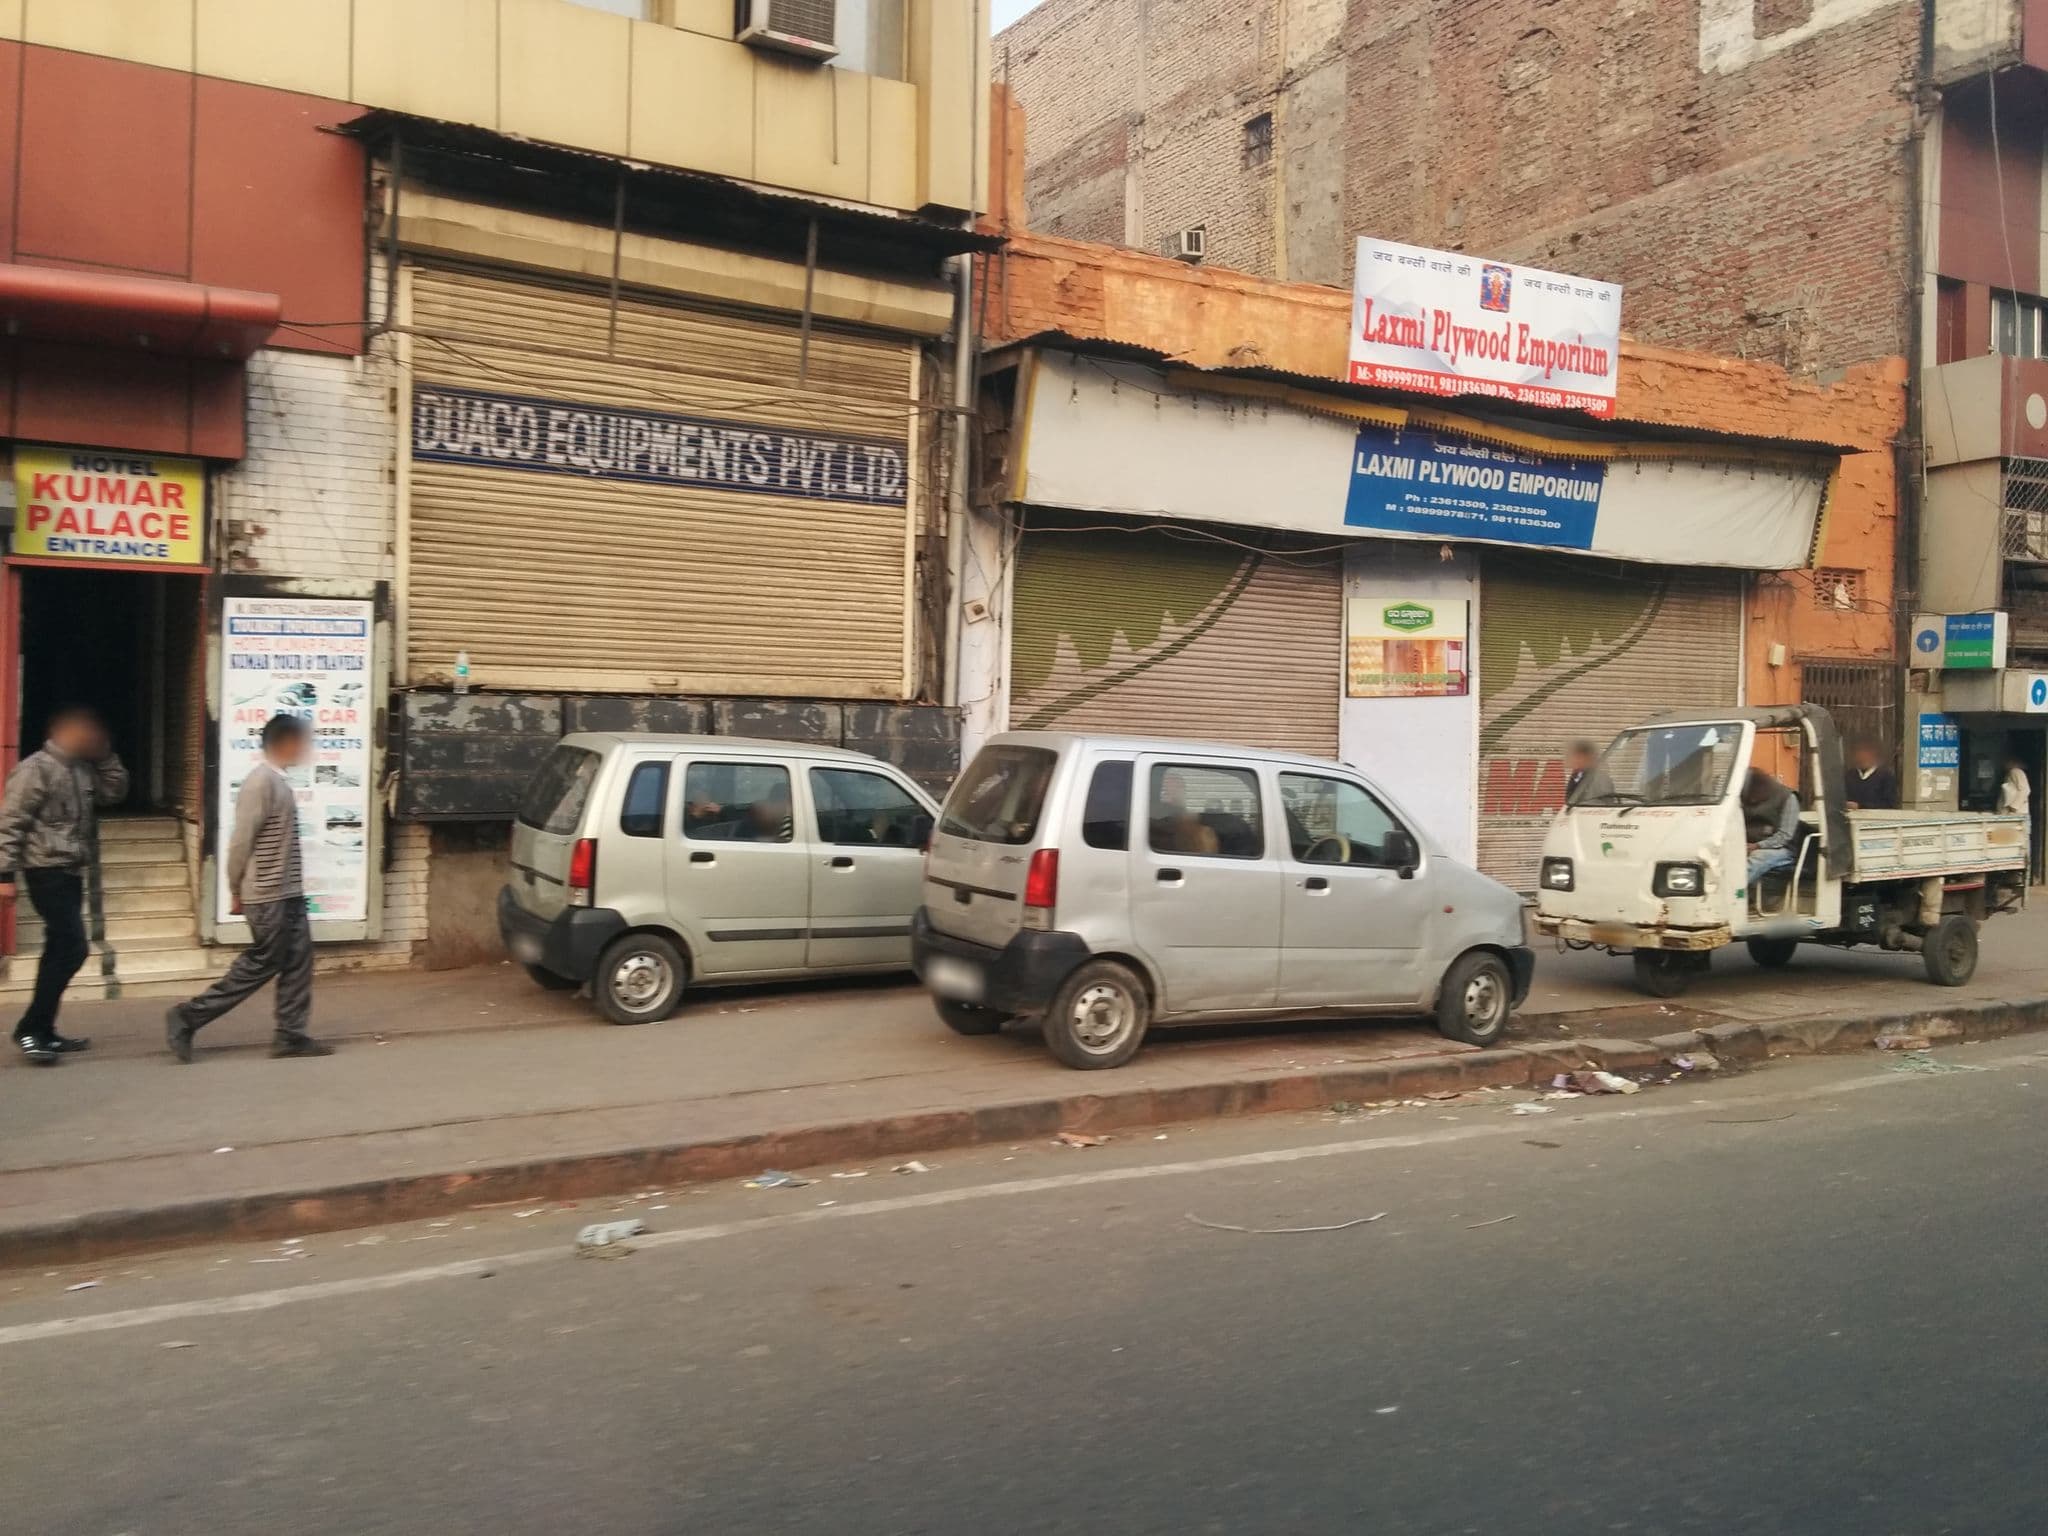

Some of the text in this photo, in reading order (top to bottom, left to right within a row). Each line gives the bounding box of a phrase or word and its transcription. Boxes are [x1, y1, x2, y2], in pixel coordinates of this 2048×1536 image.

[1362, 298, 1609, 379] Laxmi Plywood Emporium
[545, 409, 770, 484] EQUIPMENTS
[72, 456, 159, 477] HOTEL
[1356, 452, 1600, 502] LAXMI PLYWOOD EMPORIUM
[33, 473, 186, 509] KUMAR
[27, 504, 190, 540] PALACE
[1491, 514, 1562, 529] 9811836300
[1492, 503, 1548, 516] 23623509
[48, 537, 169, 558] ENTRANCE
[234, 709, 268, 722] AIR
[318, 709, 357, 723] CAR
